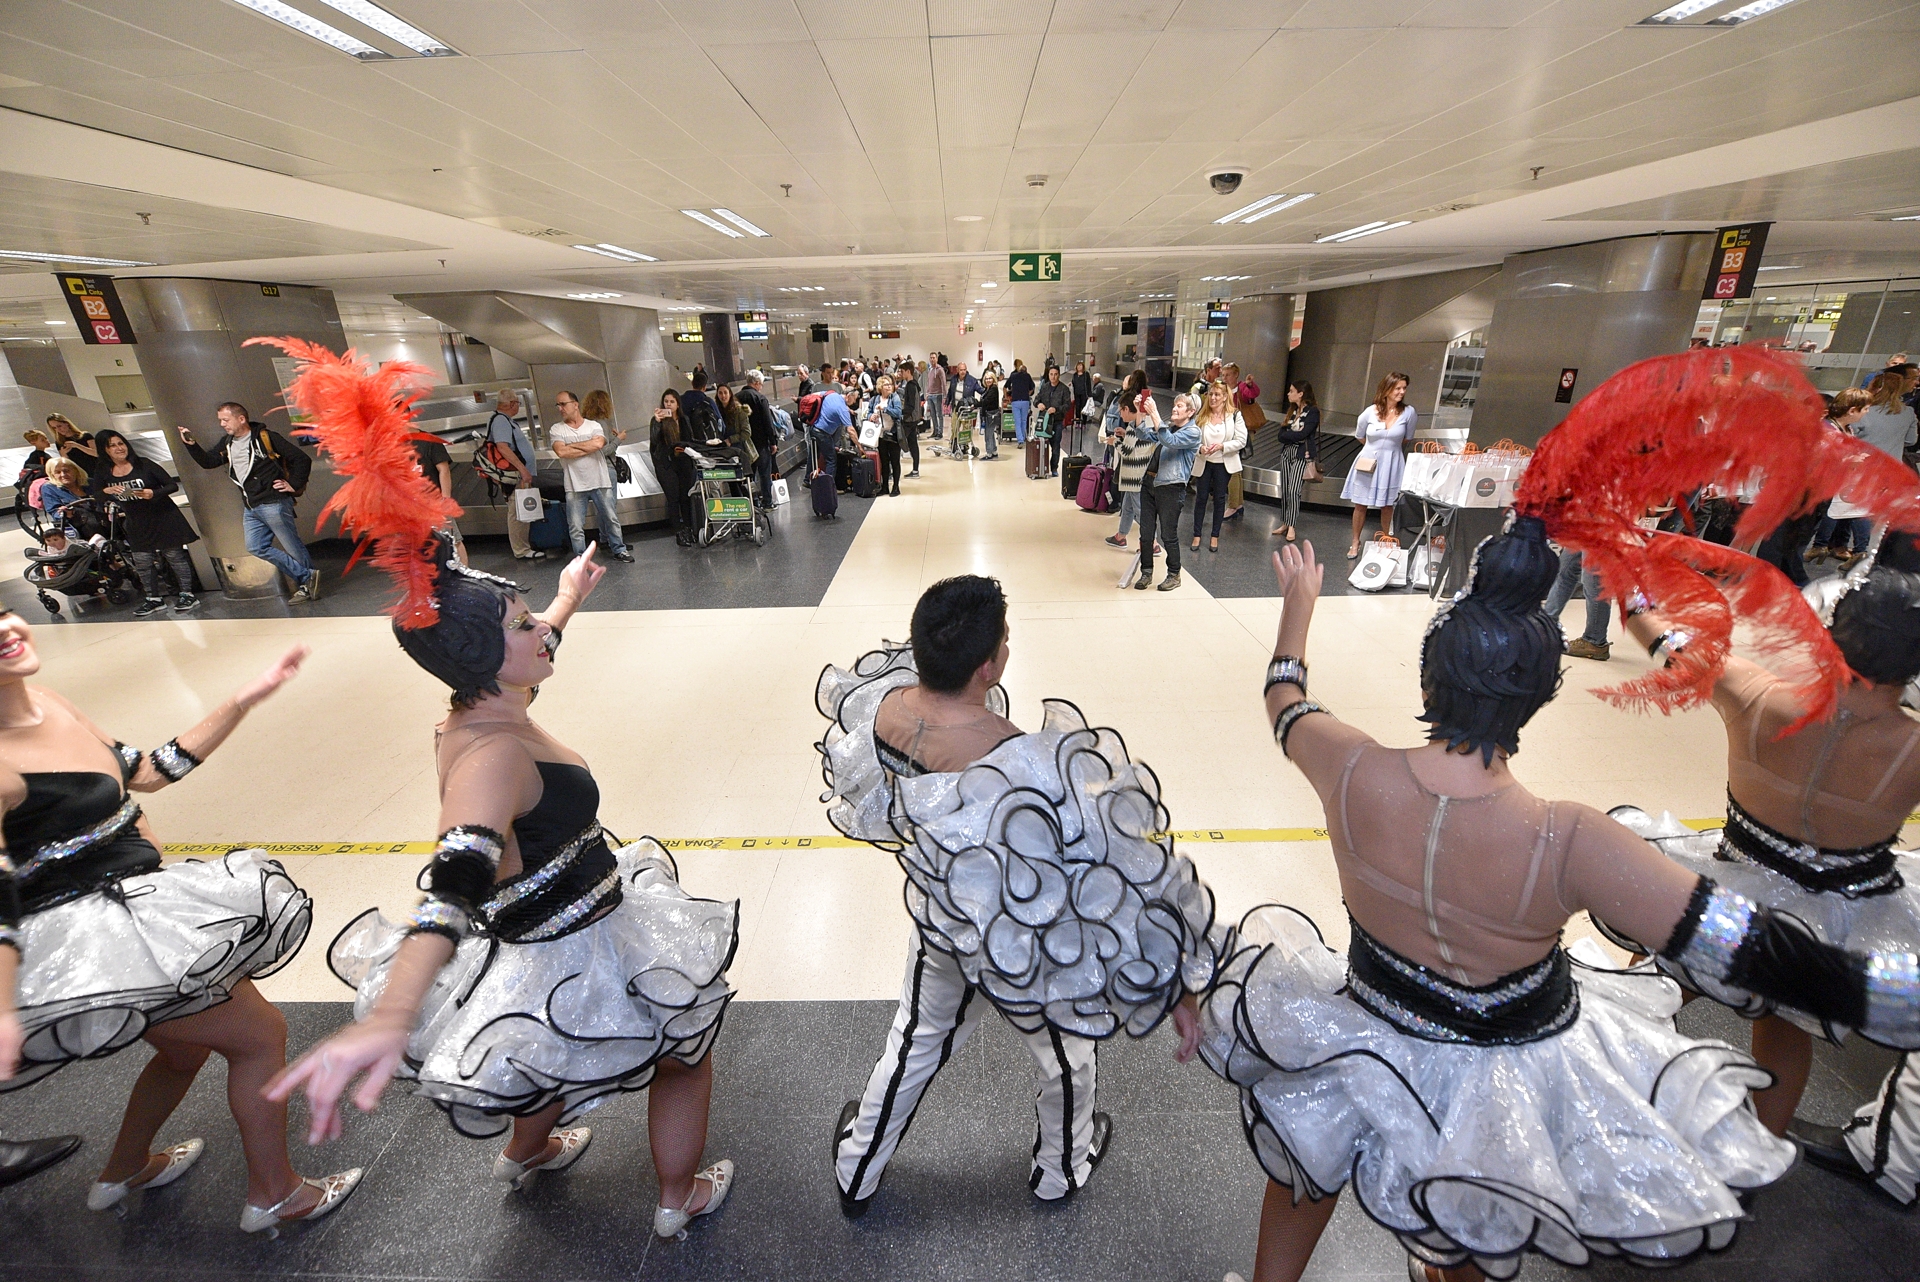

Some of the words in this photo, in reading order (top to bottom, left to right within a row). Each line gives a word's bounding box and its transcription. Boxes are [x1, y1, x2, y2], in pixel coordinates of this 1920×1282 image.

[1722, 252, 1744, 269] B3
[262, 286, 277, 295] G17
[1716, 278, 1737, 294] C3
[83, 300, 109, 315] B2
[95, 325, 119, 340] C2
[685, 840, 724, 848] ZONA
